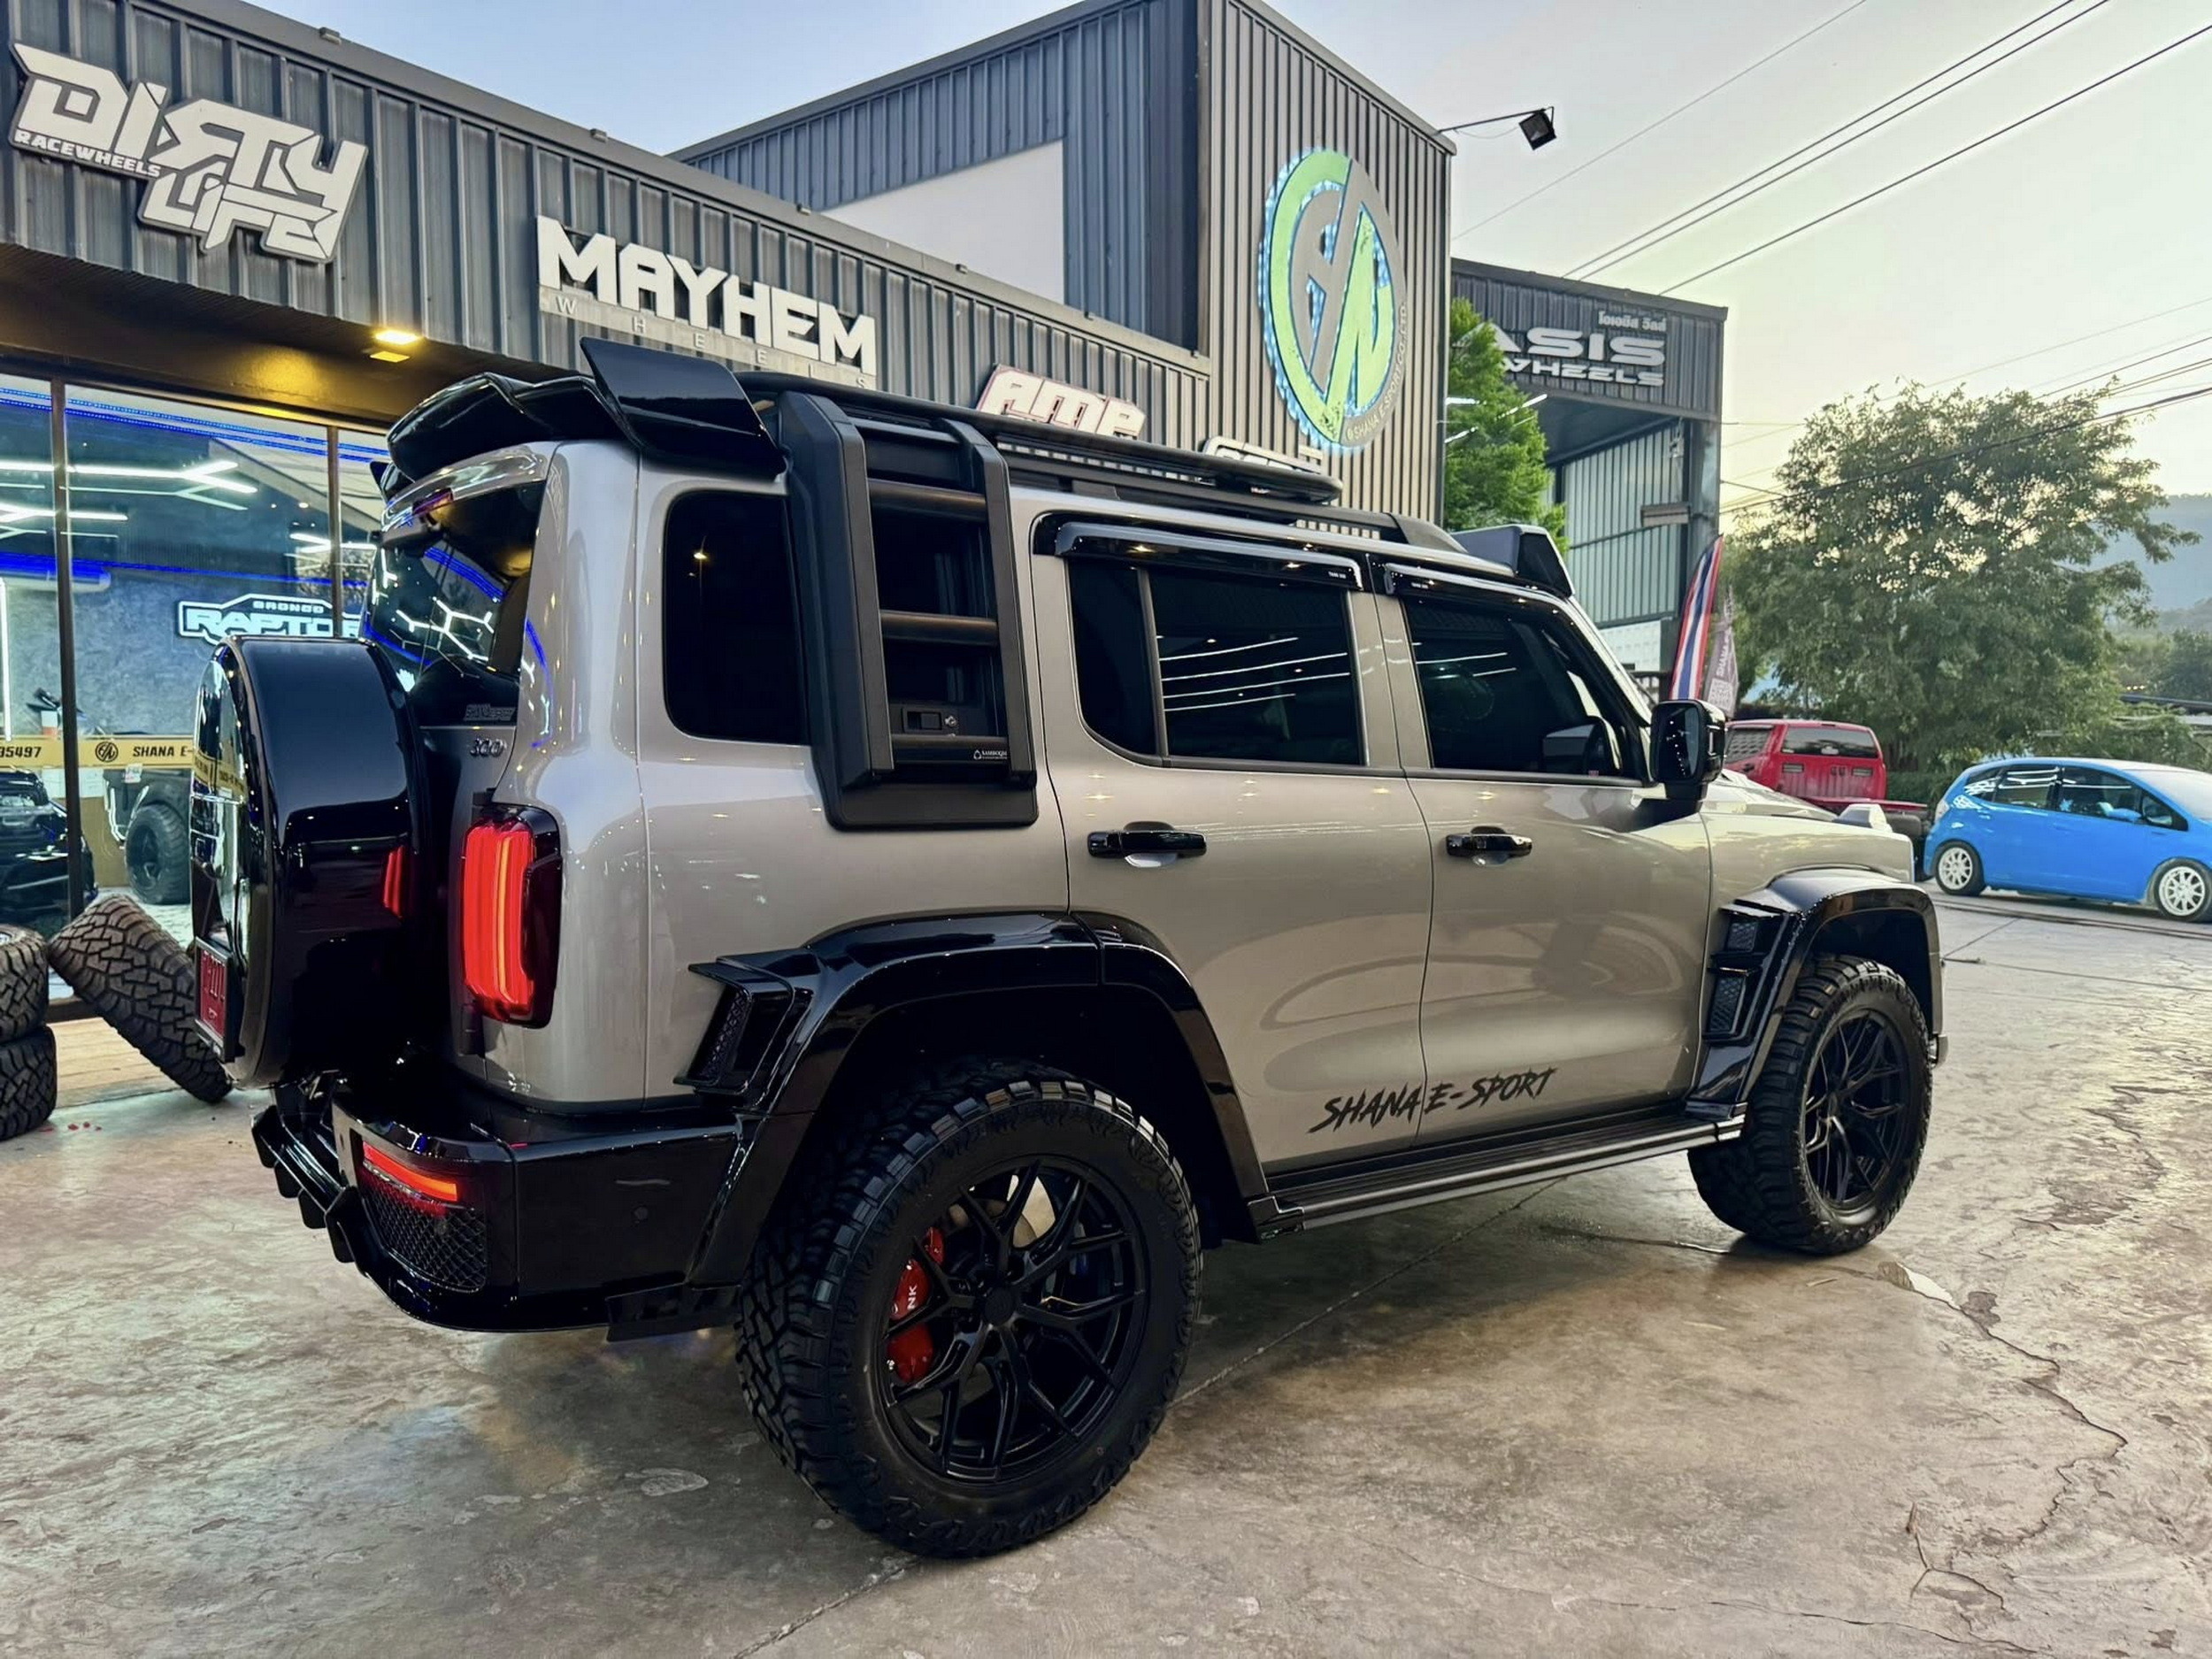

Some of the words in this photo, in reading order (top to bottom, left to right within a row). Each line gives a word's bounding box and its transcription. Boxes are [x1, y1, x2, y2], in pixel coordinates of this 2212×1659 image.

[14, 128, 162, 178] RACEWHEELS
[537, 215, 877, 375] MAYHEM
[253, 601, 324, 614] BRONCO
[133, 746, 175, 757] SHANA
[1306, 1082, 1421, 1133] SHANA
[1424, 1066, 1559, 1115] E-SPORT
